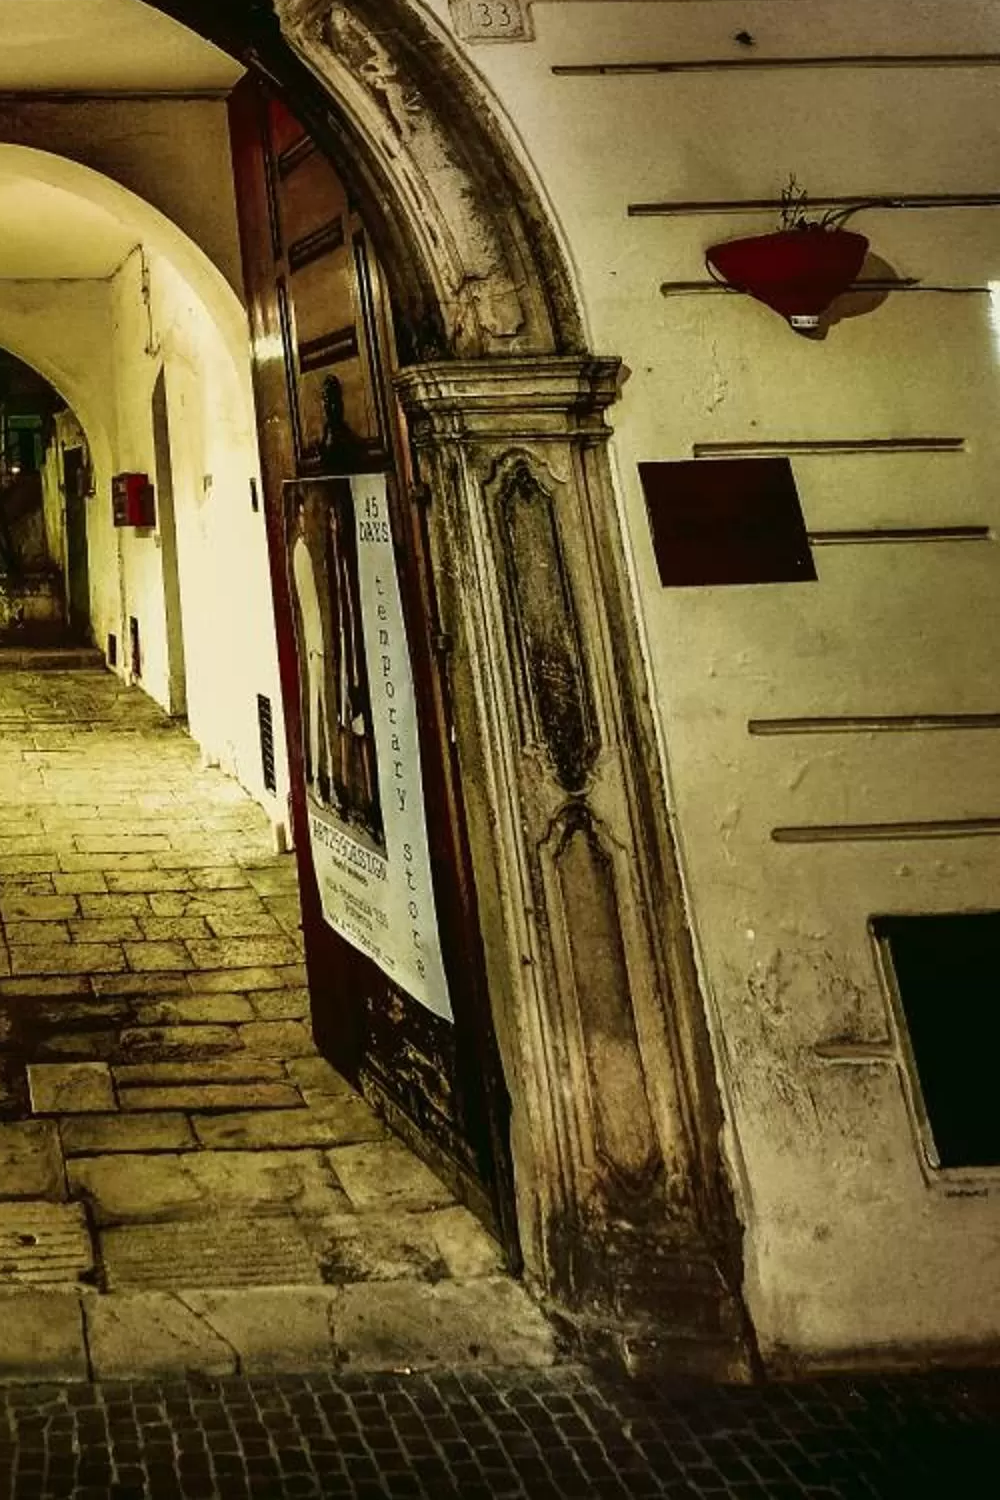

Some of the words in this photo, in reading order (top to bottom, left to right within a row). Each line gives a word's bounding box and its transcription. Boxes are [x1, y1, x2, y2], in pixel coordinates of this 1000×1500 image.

[364, 496, 379, 518] 45
[359, 521, 389, 543] DAYS
[403, 843, 425, 979] store
